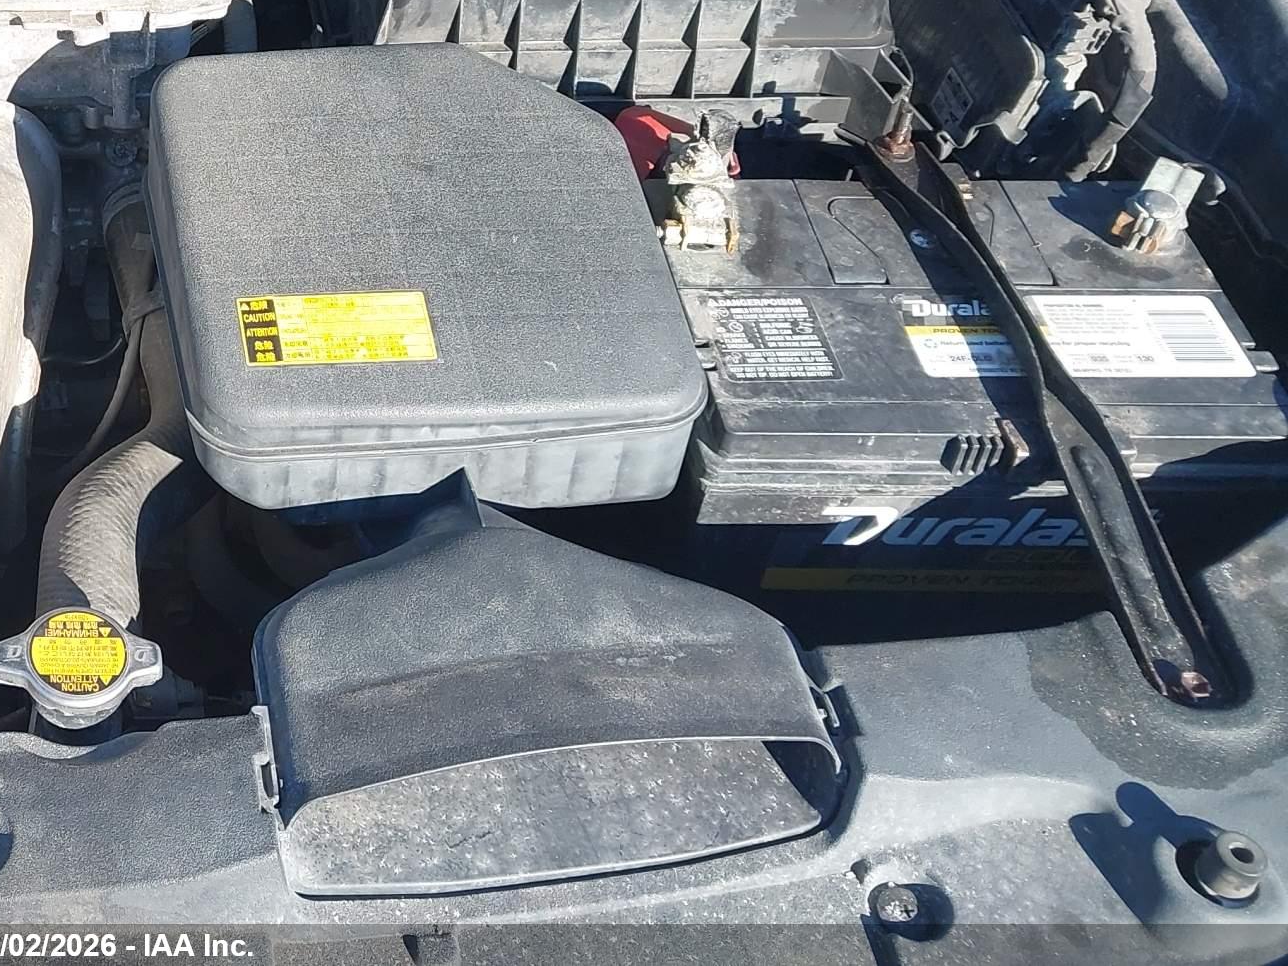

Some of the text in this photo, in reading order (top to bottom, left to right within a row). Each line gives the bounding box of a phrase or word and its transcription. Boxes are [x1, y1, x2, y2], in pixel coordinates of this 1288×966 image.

[243, 312, 276, 323] CAUTION
[246, 326, 278, 338] ATTENTION
[45, 628, 99, 637] ВНИМАНИЕ!
[50, 674, 99, 683] ATTENTION
[61, 683, 100, 692] CAUTION
